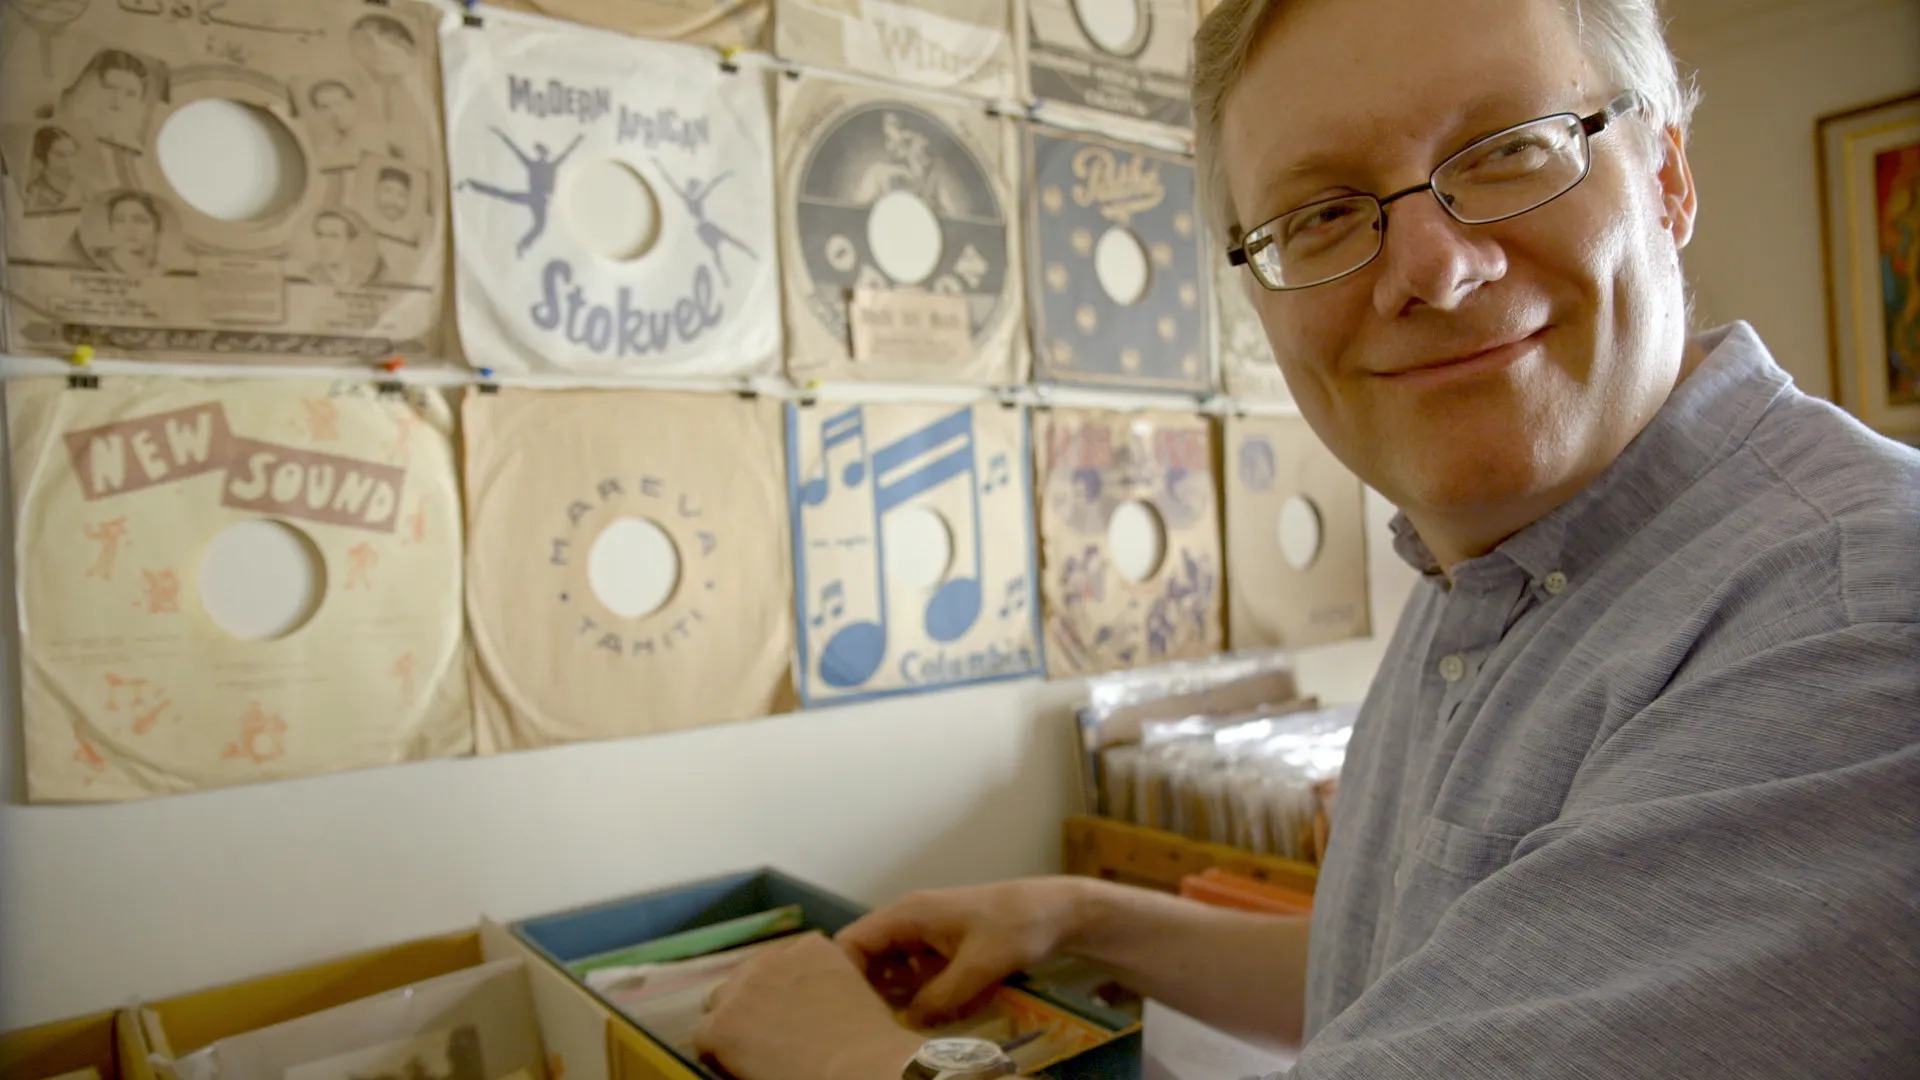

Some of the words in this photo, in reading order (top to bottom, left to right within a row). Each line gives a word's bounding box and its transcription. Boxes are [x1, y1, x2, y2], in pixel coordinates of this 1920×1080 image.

[530, 259, 724, 356] Stokvel
[88, 411, 215, 494] NEW
[228, 452, 397, 524] SOUND
[550, 476, 718, 566] MAREVA
[578, 608, 704, 658] TAHITI
